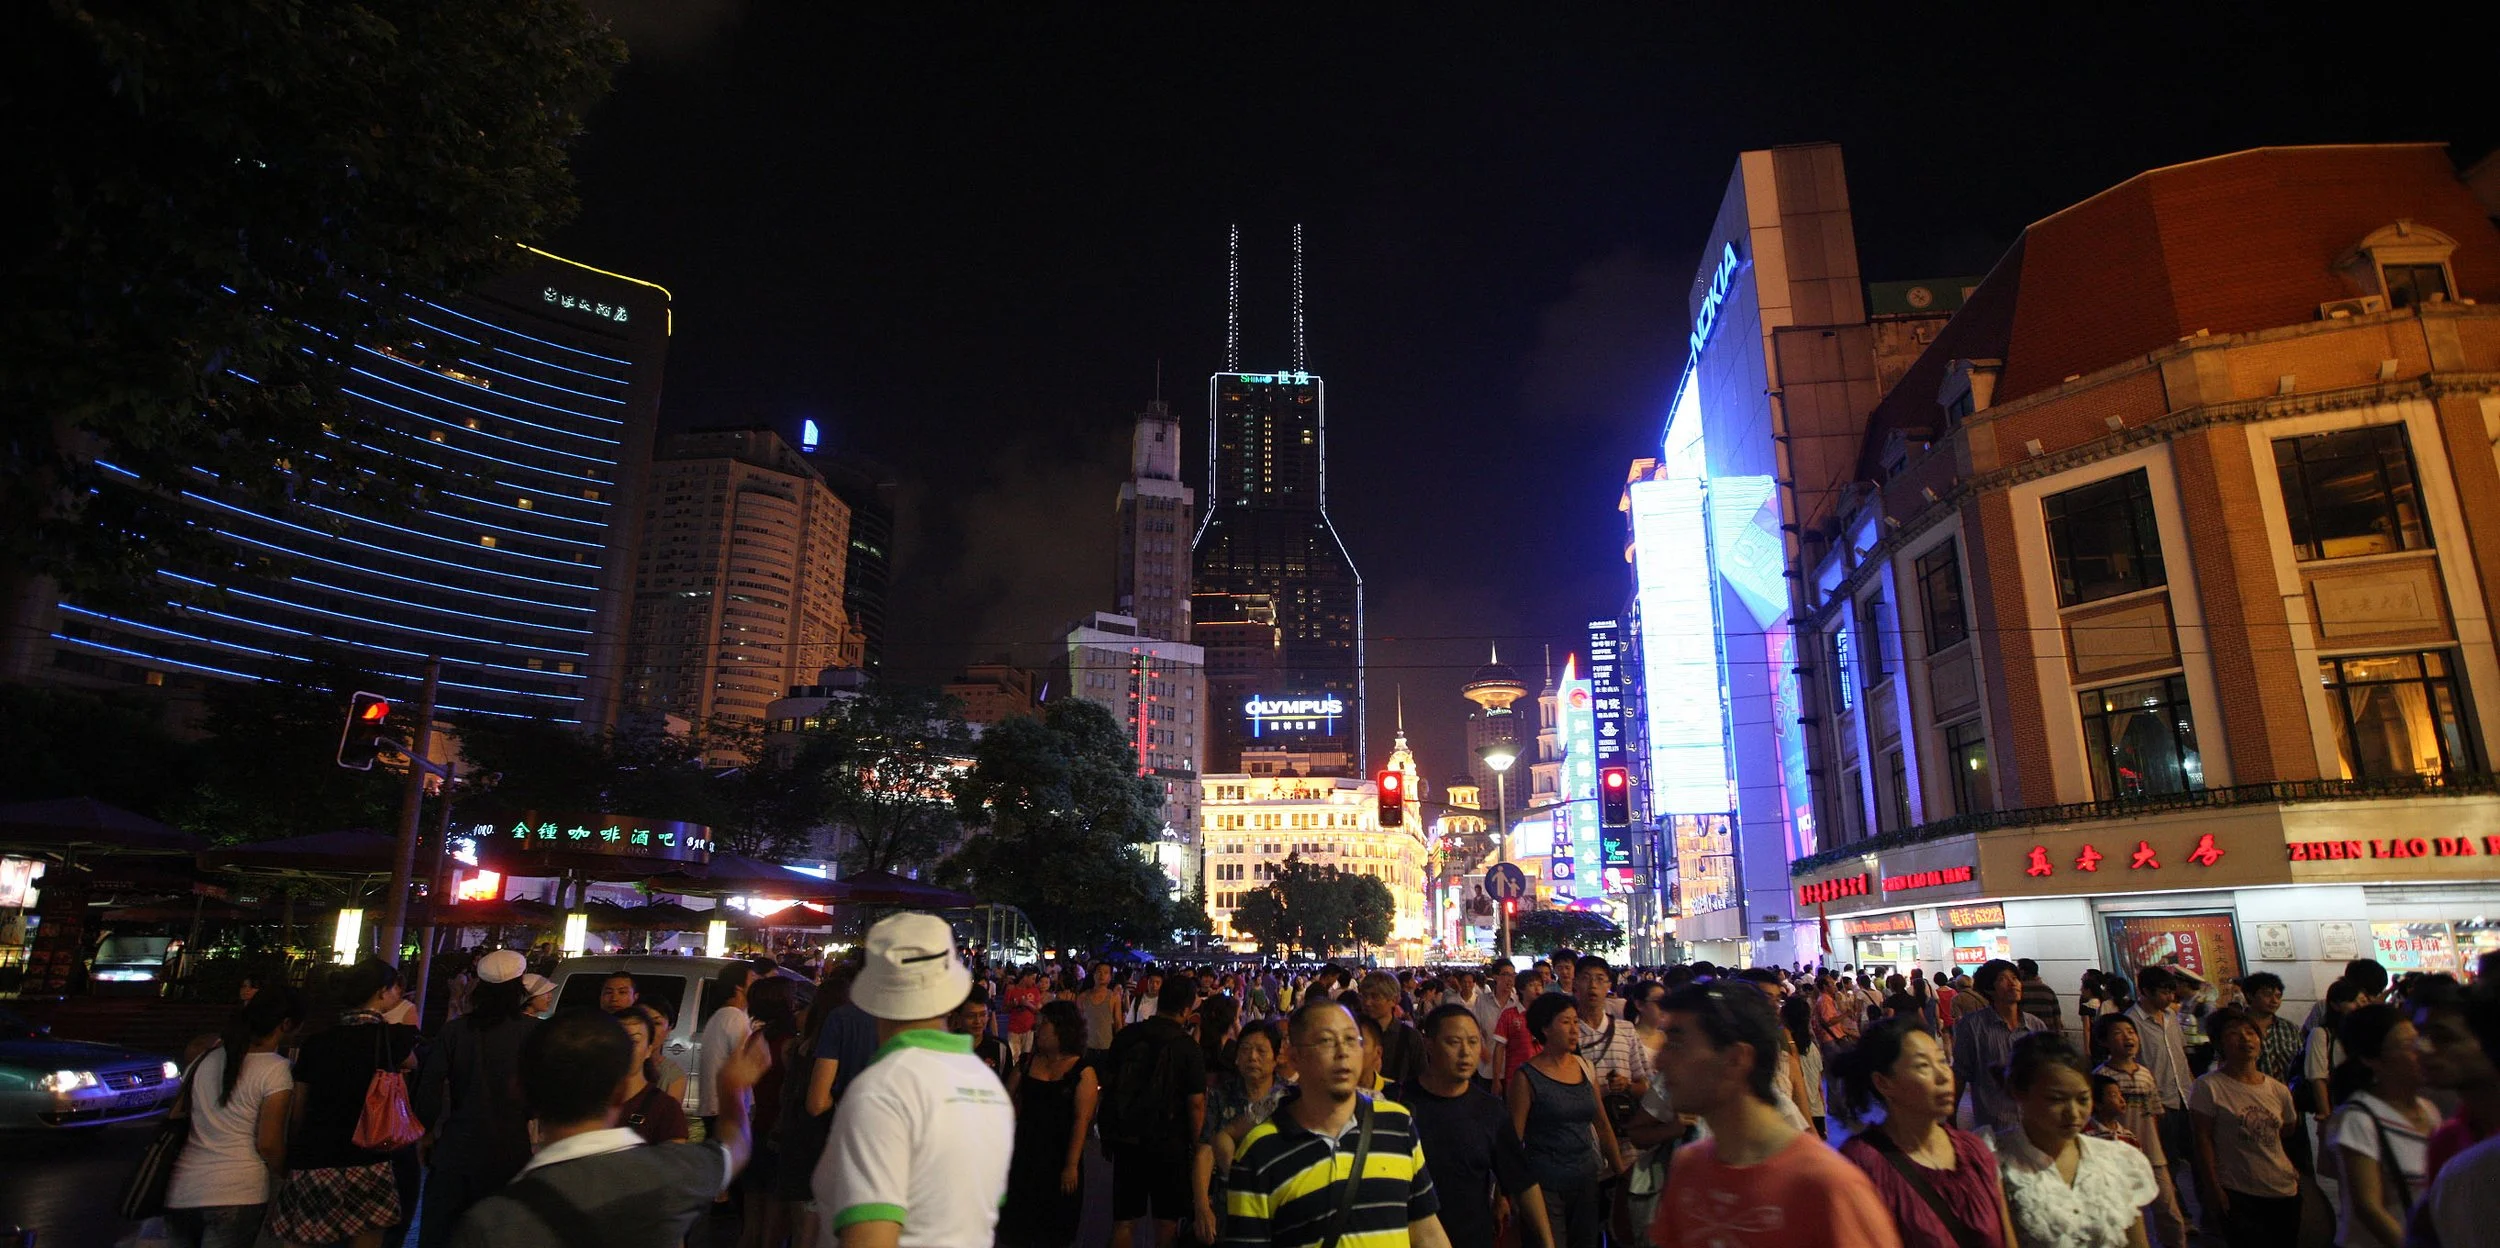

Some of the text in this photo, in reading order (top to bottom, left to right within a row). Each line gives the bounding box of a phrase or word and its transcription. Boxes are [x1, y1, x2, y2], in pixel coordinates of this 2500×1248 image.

[1691, 242, 1737, 364] NOKIA
[1245, 699, 1343, 715] OLYMPUS
[1596, 699, 1621, 710] 陶瓷
[1625, 707, 1634, 718] 5
[1627, 741, 1637, 752] 4
[1630, 775, 1639, 786] 3
[1632, 810, 1641, 821] 2
[686, 836, 706, 851] BAR
[2288, 840, 2364, 862] ZHEN
[2371, 836, 2429, 859] LAO
[2436, 835, 2477, 857] DA
[2026, 833, 2225, 877] 真老大房
[1634, 874, 1647, 886] B1
[2378, 936, 2441, 952] 鲜肉月饼
